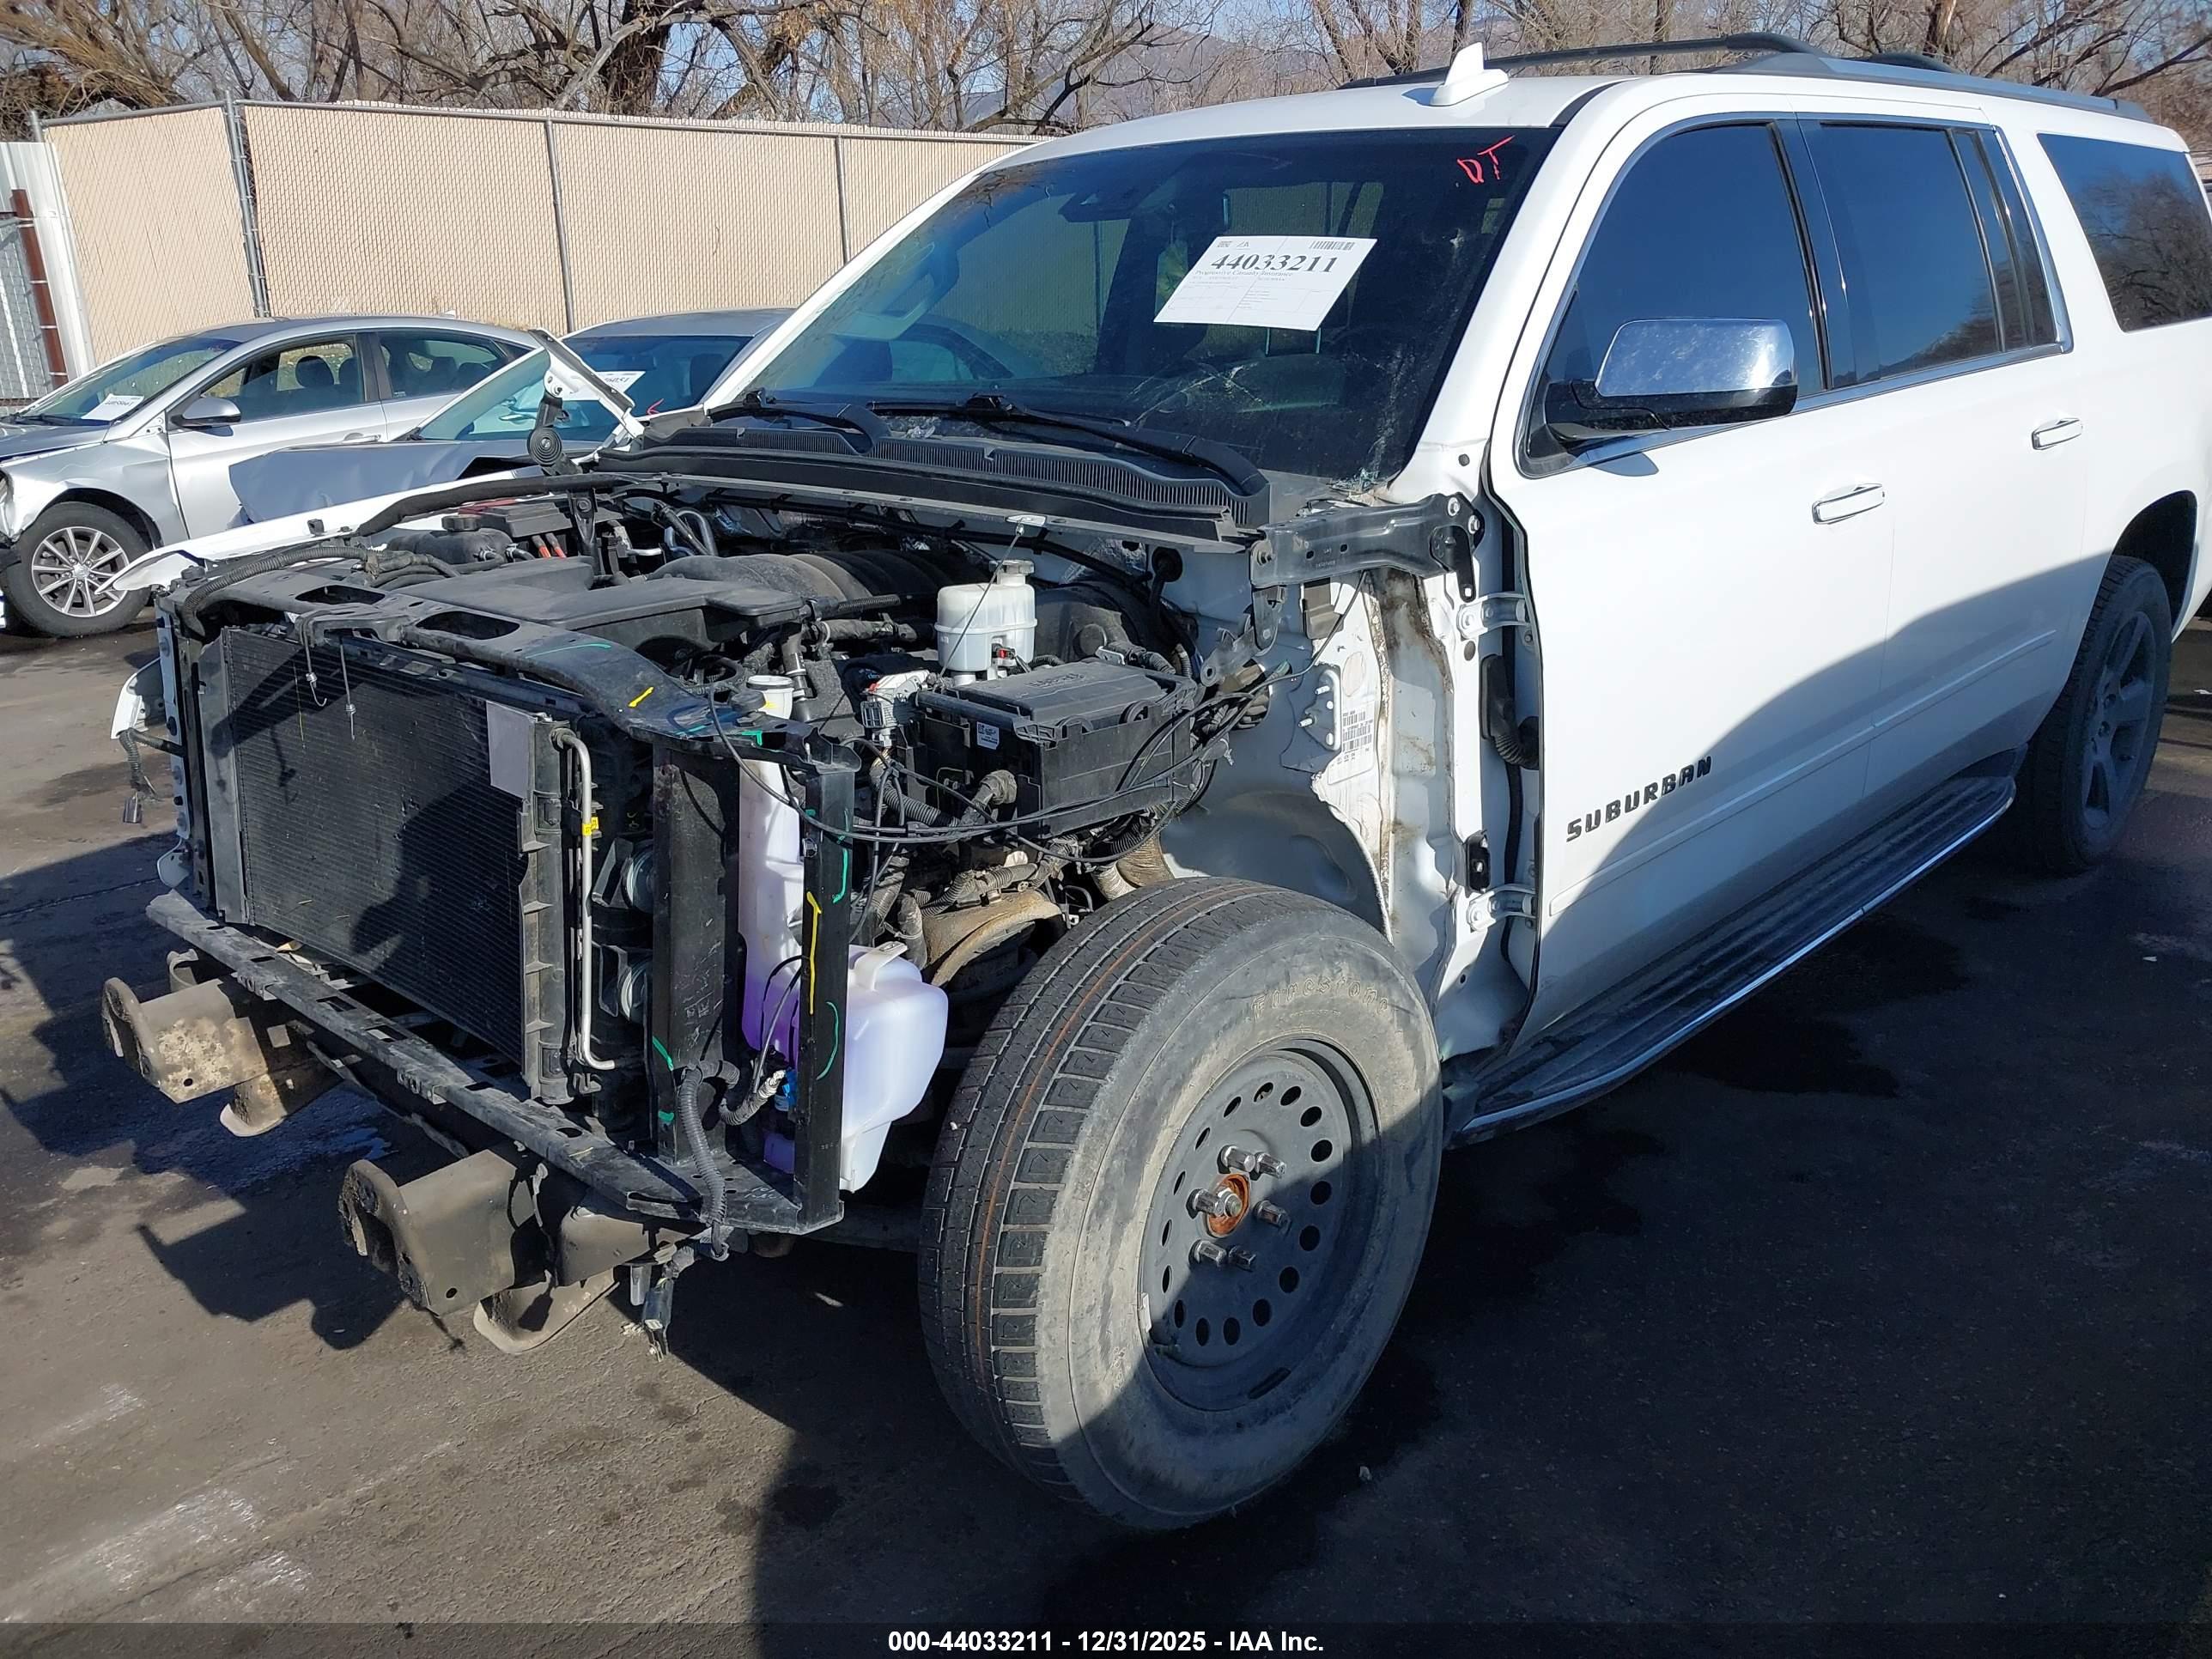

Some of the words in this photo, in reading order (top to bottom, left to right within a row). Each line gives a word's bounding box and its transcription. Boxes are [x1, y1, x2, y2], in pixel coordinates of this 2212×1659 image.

[1211, 252, 1339, 273] 44033211
[1566, 756, 1711, 842] SUBURBAN
[1250, 975, 1389, 1024] Firestone
